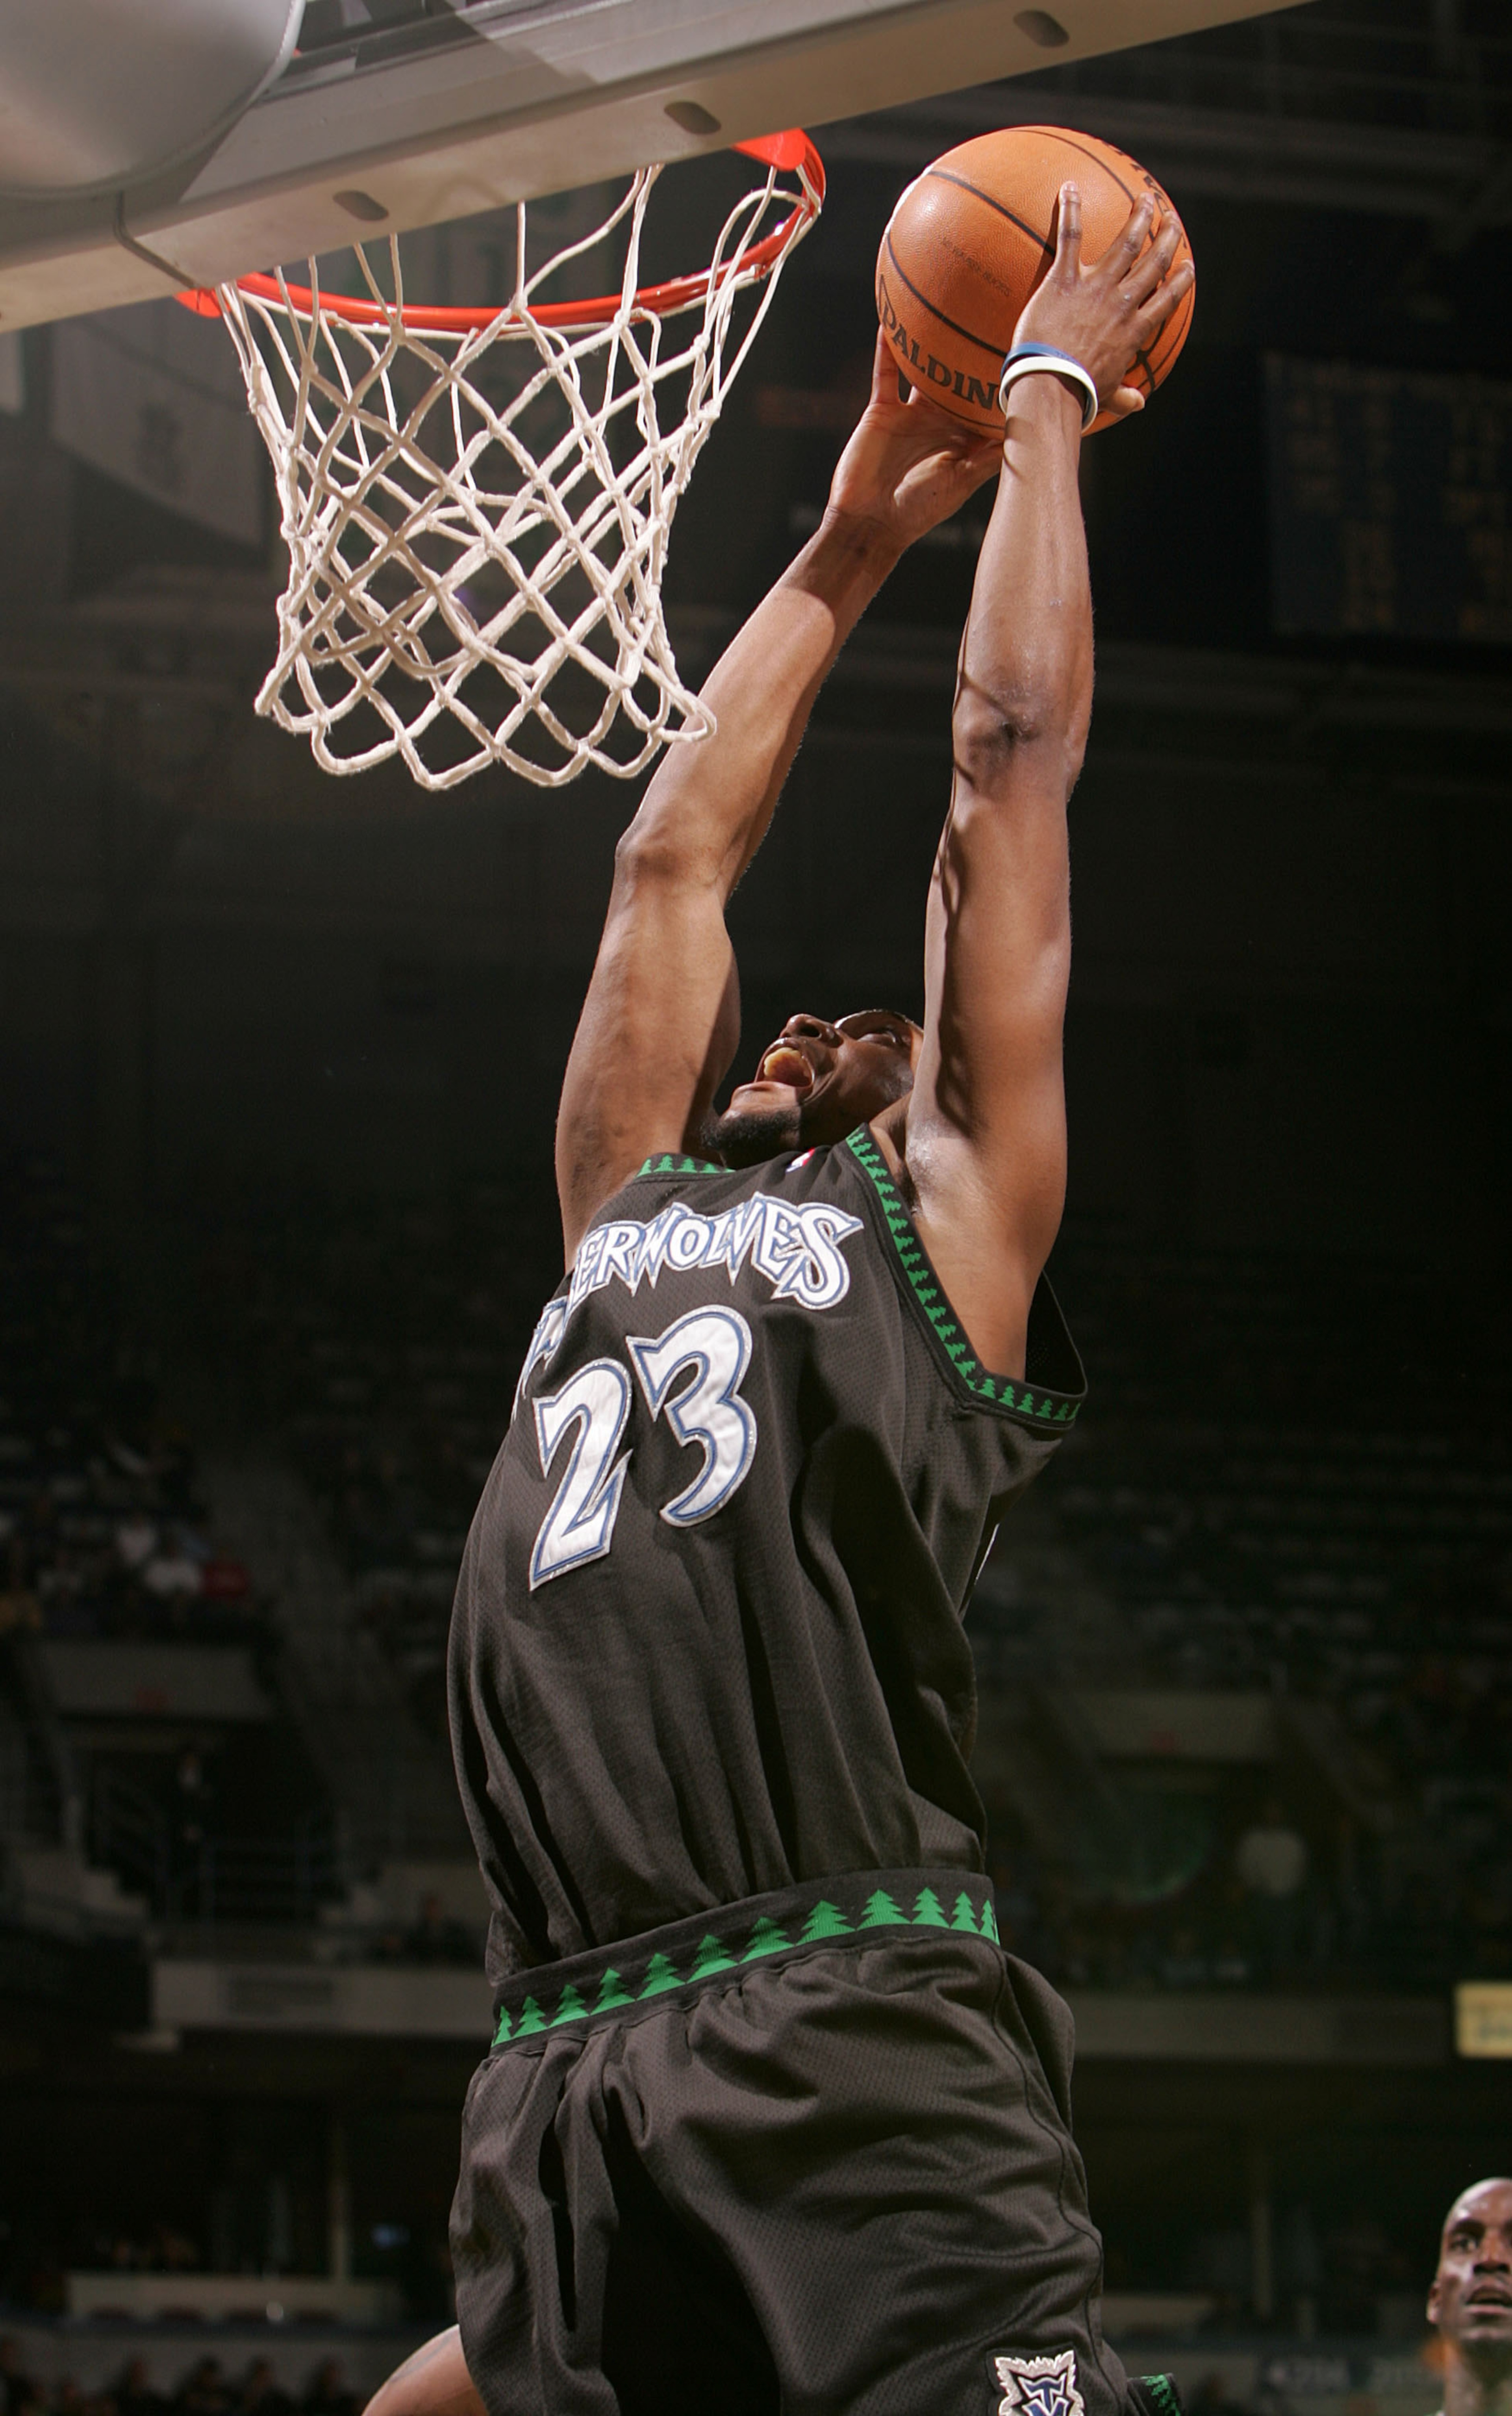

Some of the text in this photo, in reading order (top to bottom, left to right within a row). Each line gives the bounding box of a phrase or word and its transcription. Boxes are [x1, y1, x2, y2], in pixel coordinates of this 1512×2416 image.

[878, 274, 1002, 412] PALDIN
[524, 1191, 863, 1398] ERWOLVES
[529, 1304, 758, 1591] 23
